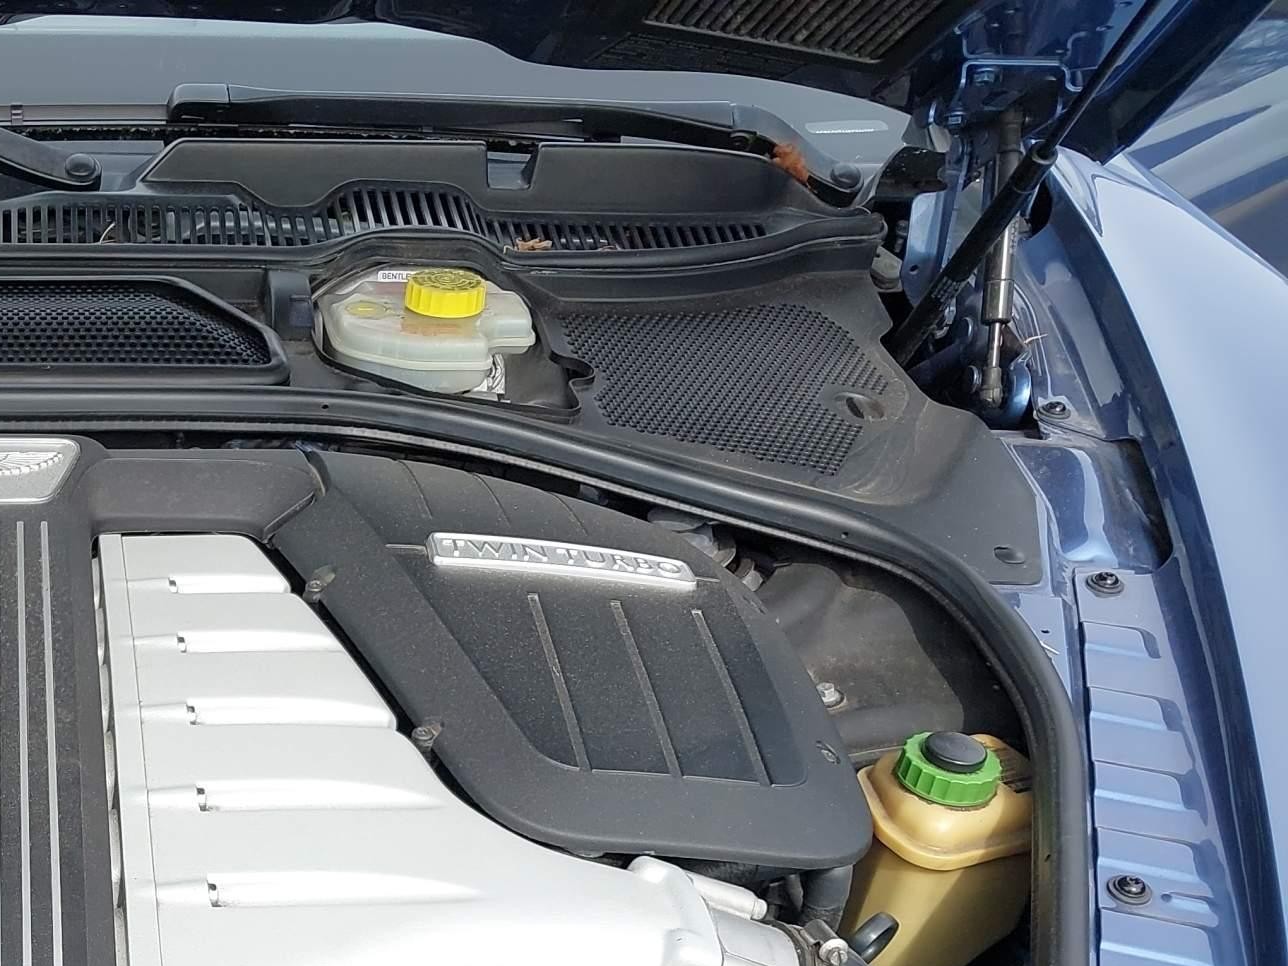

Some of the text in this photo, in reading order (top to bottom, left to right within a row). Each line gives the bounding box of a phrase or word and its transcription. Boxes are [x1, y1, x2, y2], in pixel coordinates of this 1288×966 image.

[381, 272, 411, 280] BENTLE
[442, 539, 680, 575] TWIN TURBO
